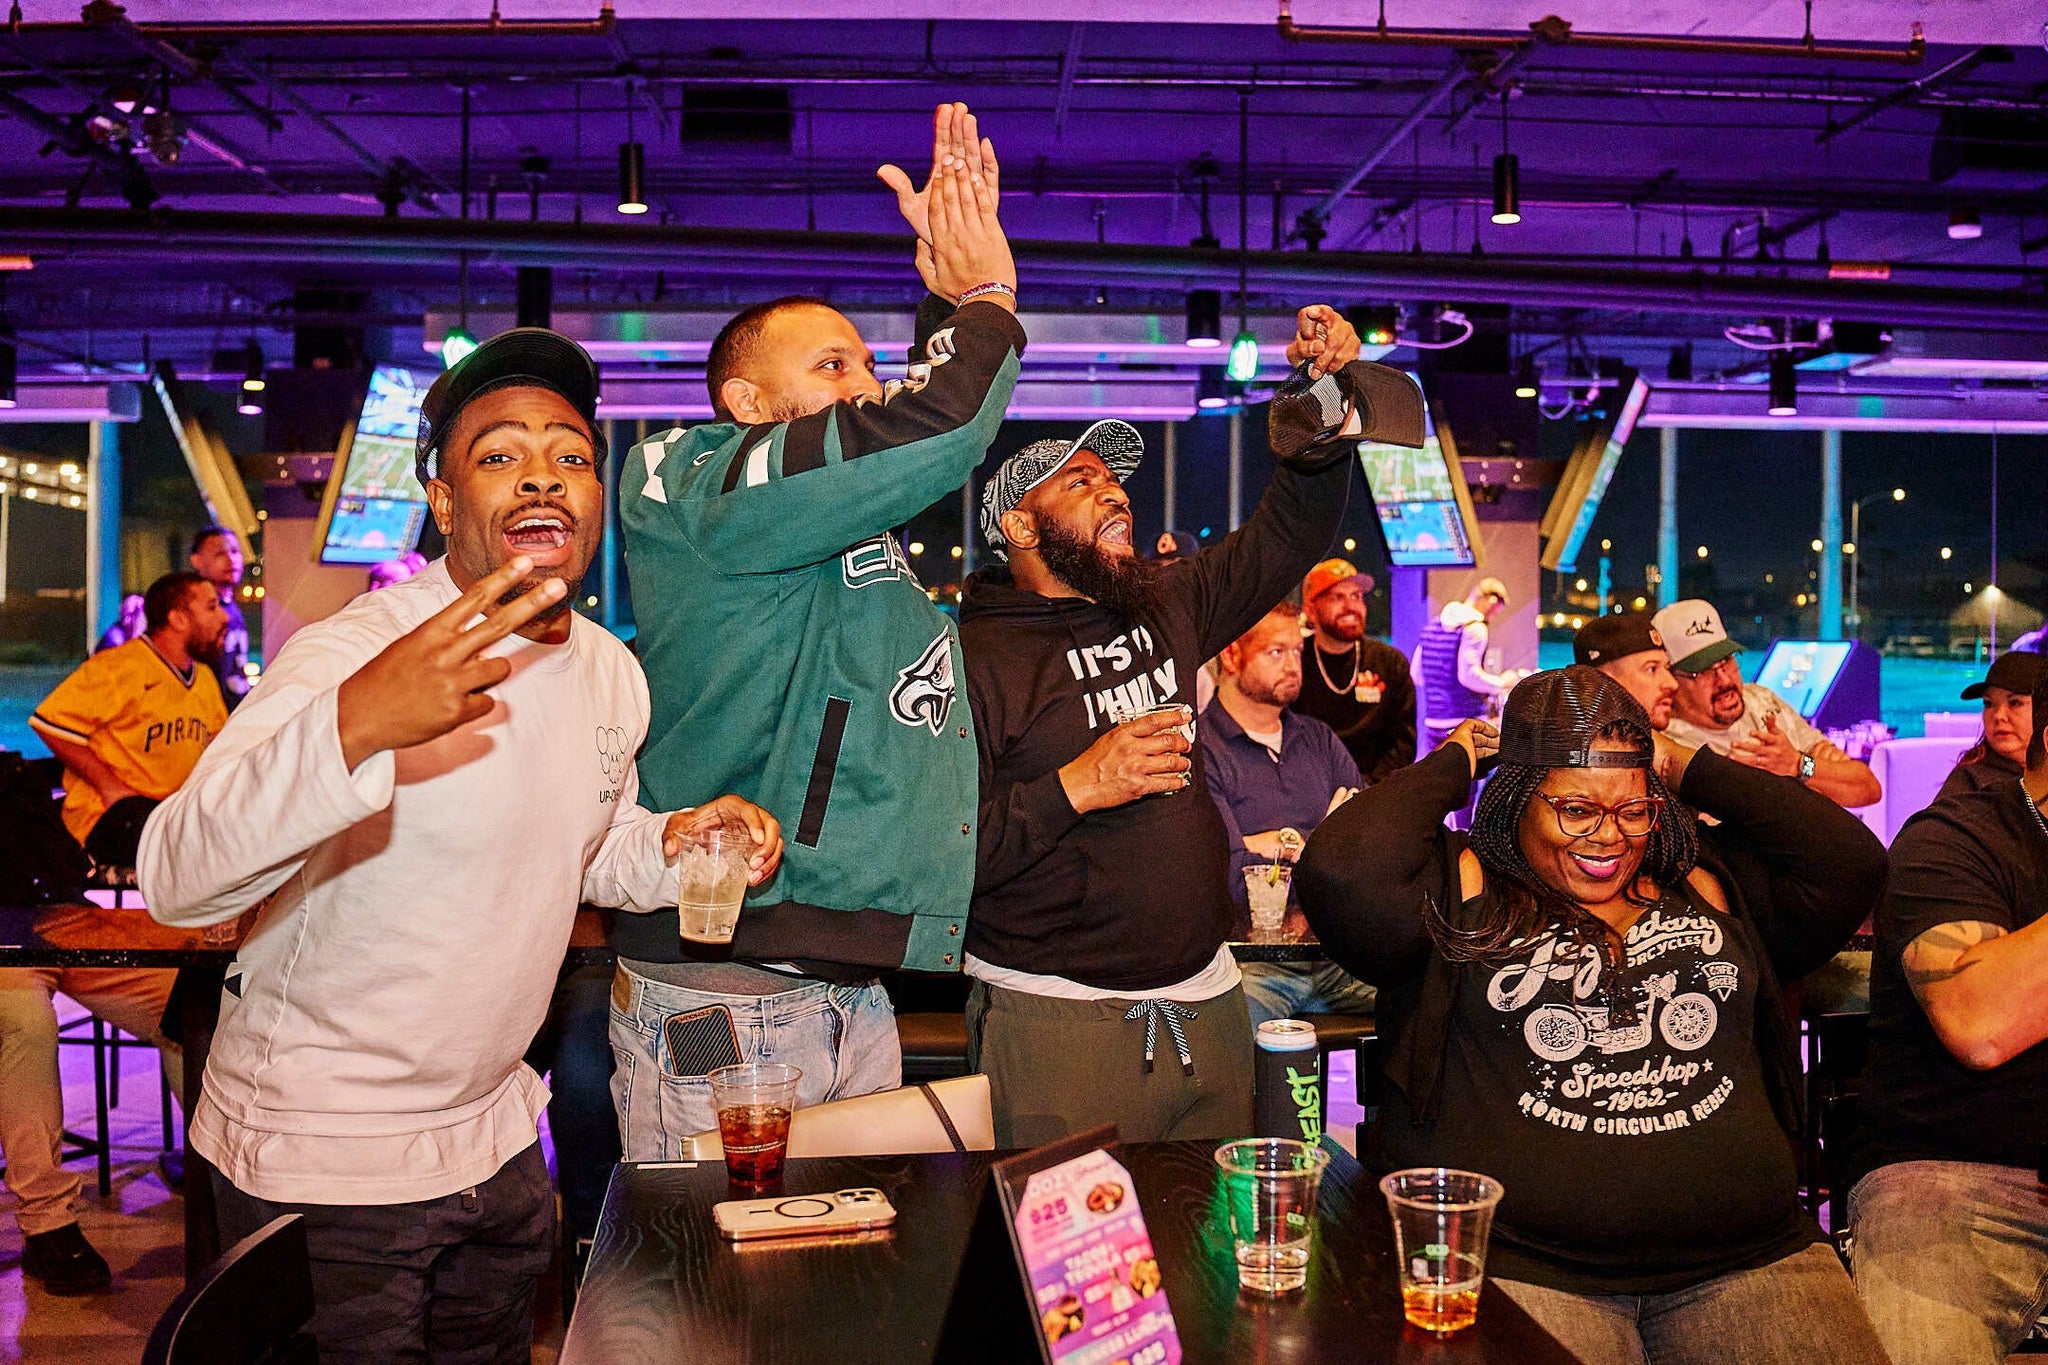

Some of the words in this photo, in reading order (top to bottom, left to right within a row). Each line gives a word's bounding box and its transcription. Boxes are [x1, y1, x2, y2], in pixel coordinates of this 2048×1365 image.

[1066, 634, 1132, 680] IT'S
[1708, 965, 1734, 976] CAFE
[1560, 1054, 1700, 1099] Speedshop
[1517, 1091, 1588, 1132] NORTH
[1593, 1109, 1691, 1136] CIRCULAR
[1690, 1075, 1735, 1122] REBELS
[1030, 1198, 1068, 1225] $25
